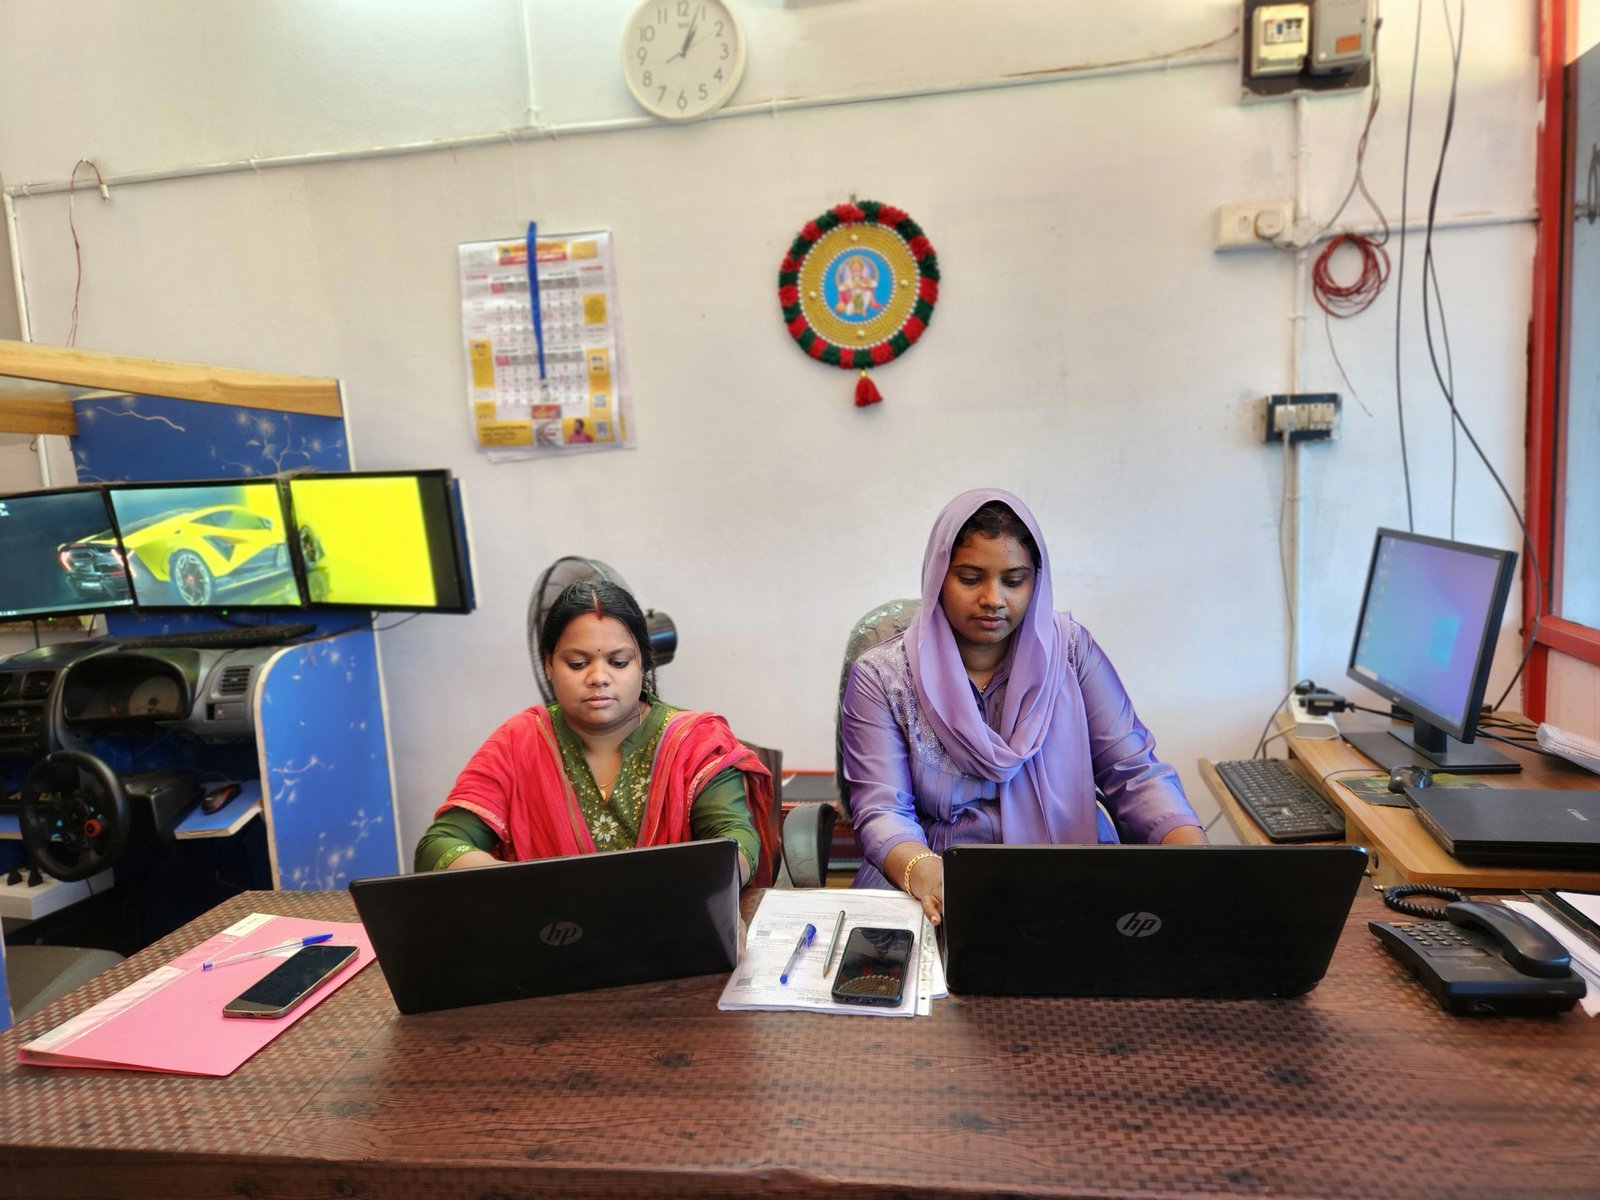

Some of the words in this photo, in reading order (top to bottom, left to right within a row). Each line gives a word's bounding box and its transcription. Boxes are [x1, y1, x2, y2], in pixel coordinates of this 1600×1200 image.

[658, 8, 668, 24] 11
[676, 0, 690, 17] 12
[702, 6, 706, 20] 1
[640, 25, 655, 42] 10
[714, 20, 724, 38] 2
[636, 46, 648, 66] 9
[720, 43, 730, 60] 3
[642, 70, 652, 88] 8
[714, 68, 724, 82] 4
[658, 86, 667, 104] 7
[677, 90, 688, 110] 6
[698, 84, 708, 100] 5
[1121, 912, 1158, 938] hp
